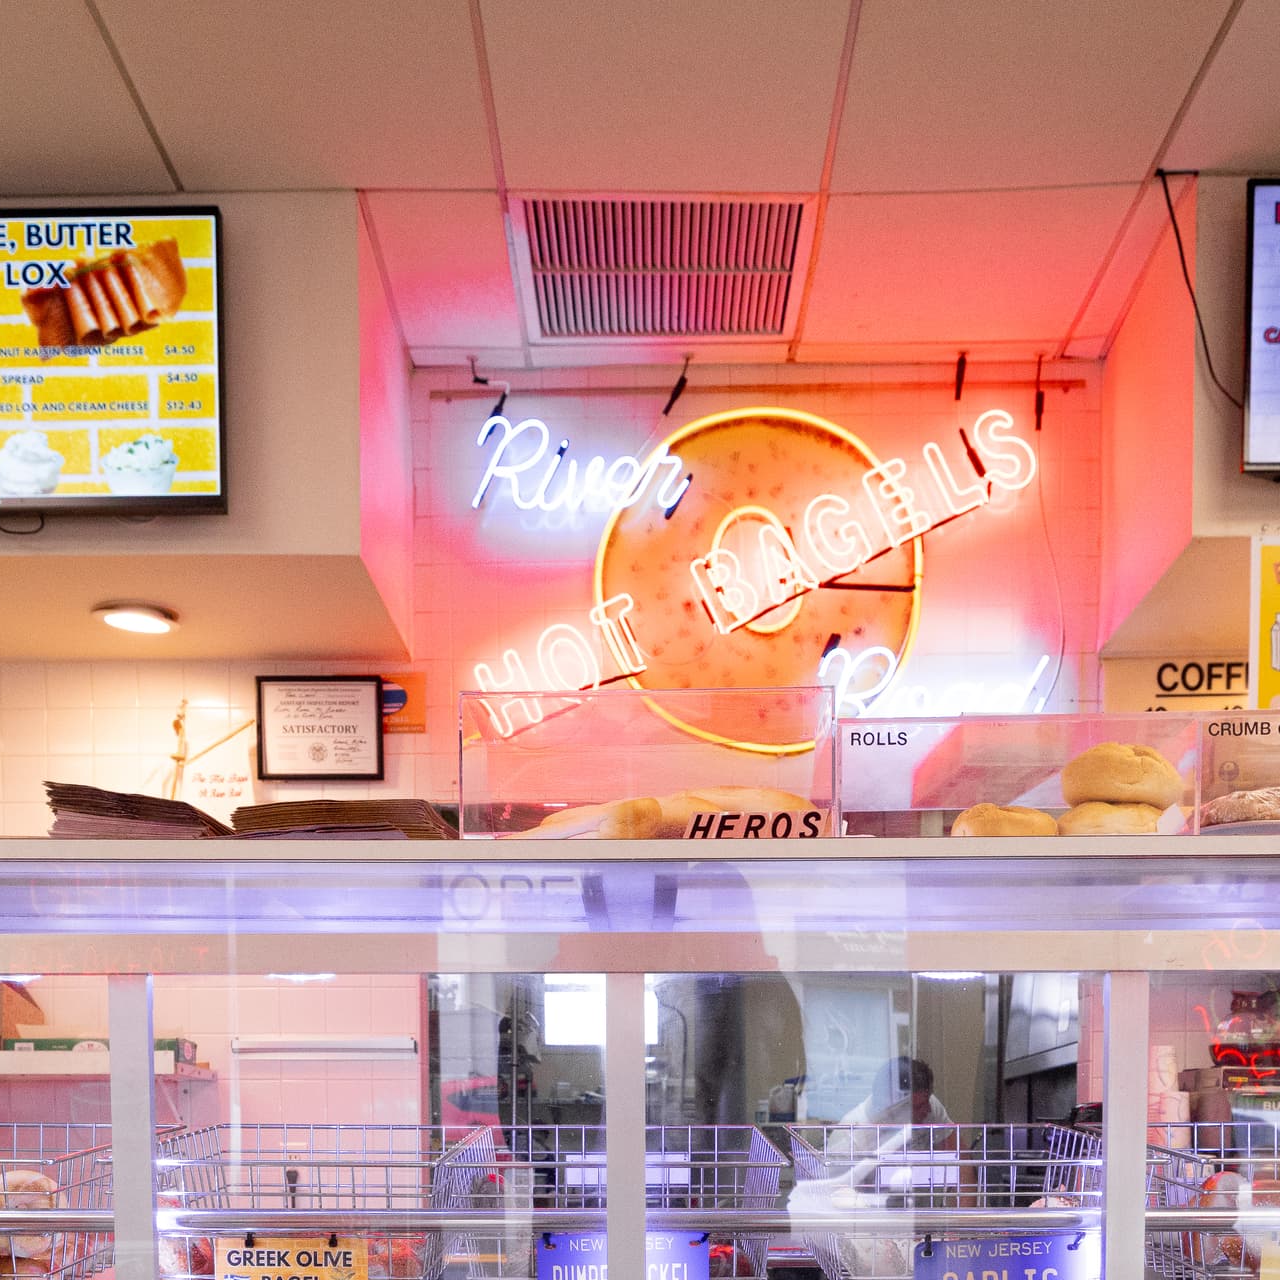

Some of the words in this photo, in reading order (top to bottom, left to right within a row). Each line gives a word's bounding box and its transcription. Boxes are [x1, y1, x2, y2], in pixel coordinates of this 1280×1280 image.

[25, 223, 135, 247] BUTTER
[6, 262, 69, 287] LOX
[104, 345, 144, 356] CHEESE
[1, 375, 44, 385] SPREAD
[16, 402, 38, 412] LOX
[42, 402, 66, 412] AND
[68, 402, 106, 412] CREAM
[109, 401, 149, 412] CHEESE
[472, 414, 693, 512] River
[472, 592, 648, 738] HOT
[687, 409, 1039, 635] BAGELS
[282, 725, 358, 734] SATISFACTORY
[1208, 722, 1272, 737] CRUMB
[850, 731, 908, 747] ROLLS
[227, 1248, 292, 1269] GREEK
[295, 1247, 352, 1268] OLIVE
[946, 1241, 984, 1259] NEW
[989, 1241, 1053, 1259] JERSEY
